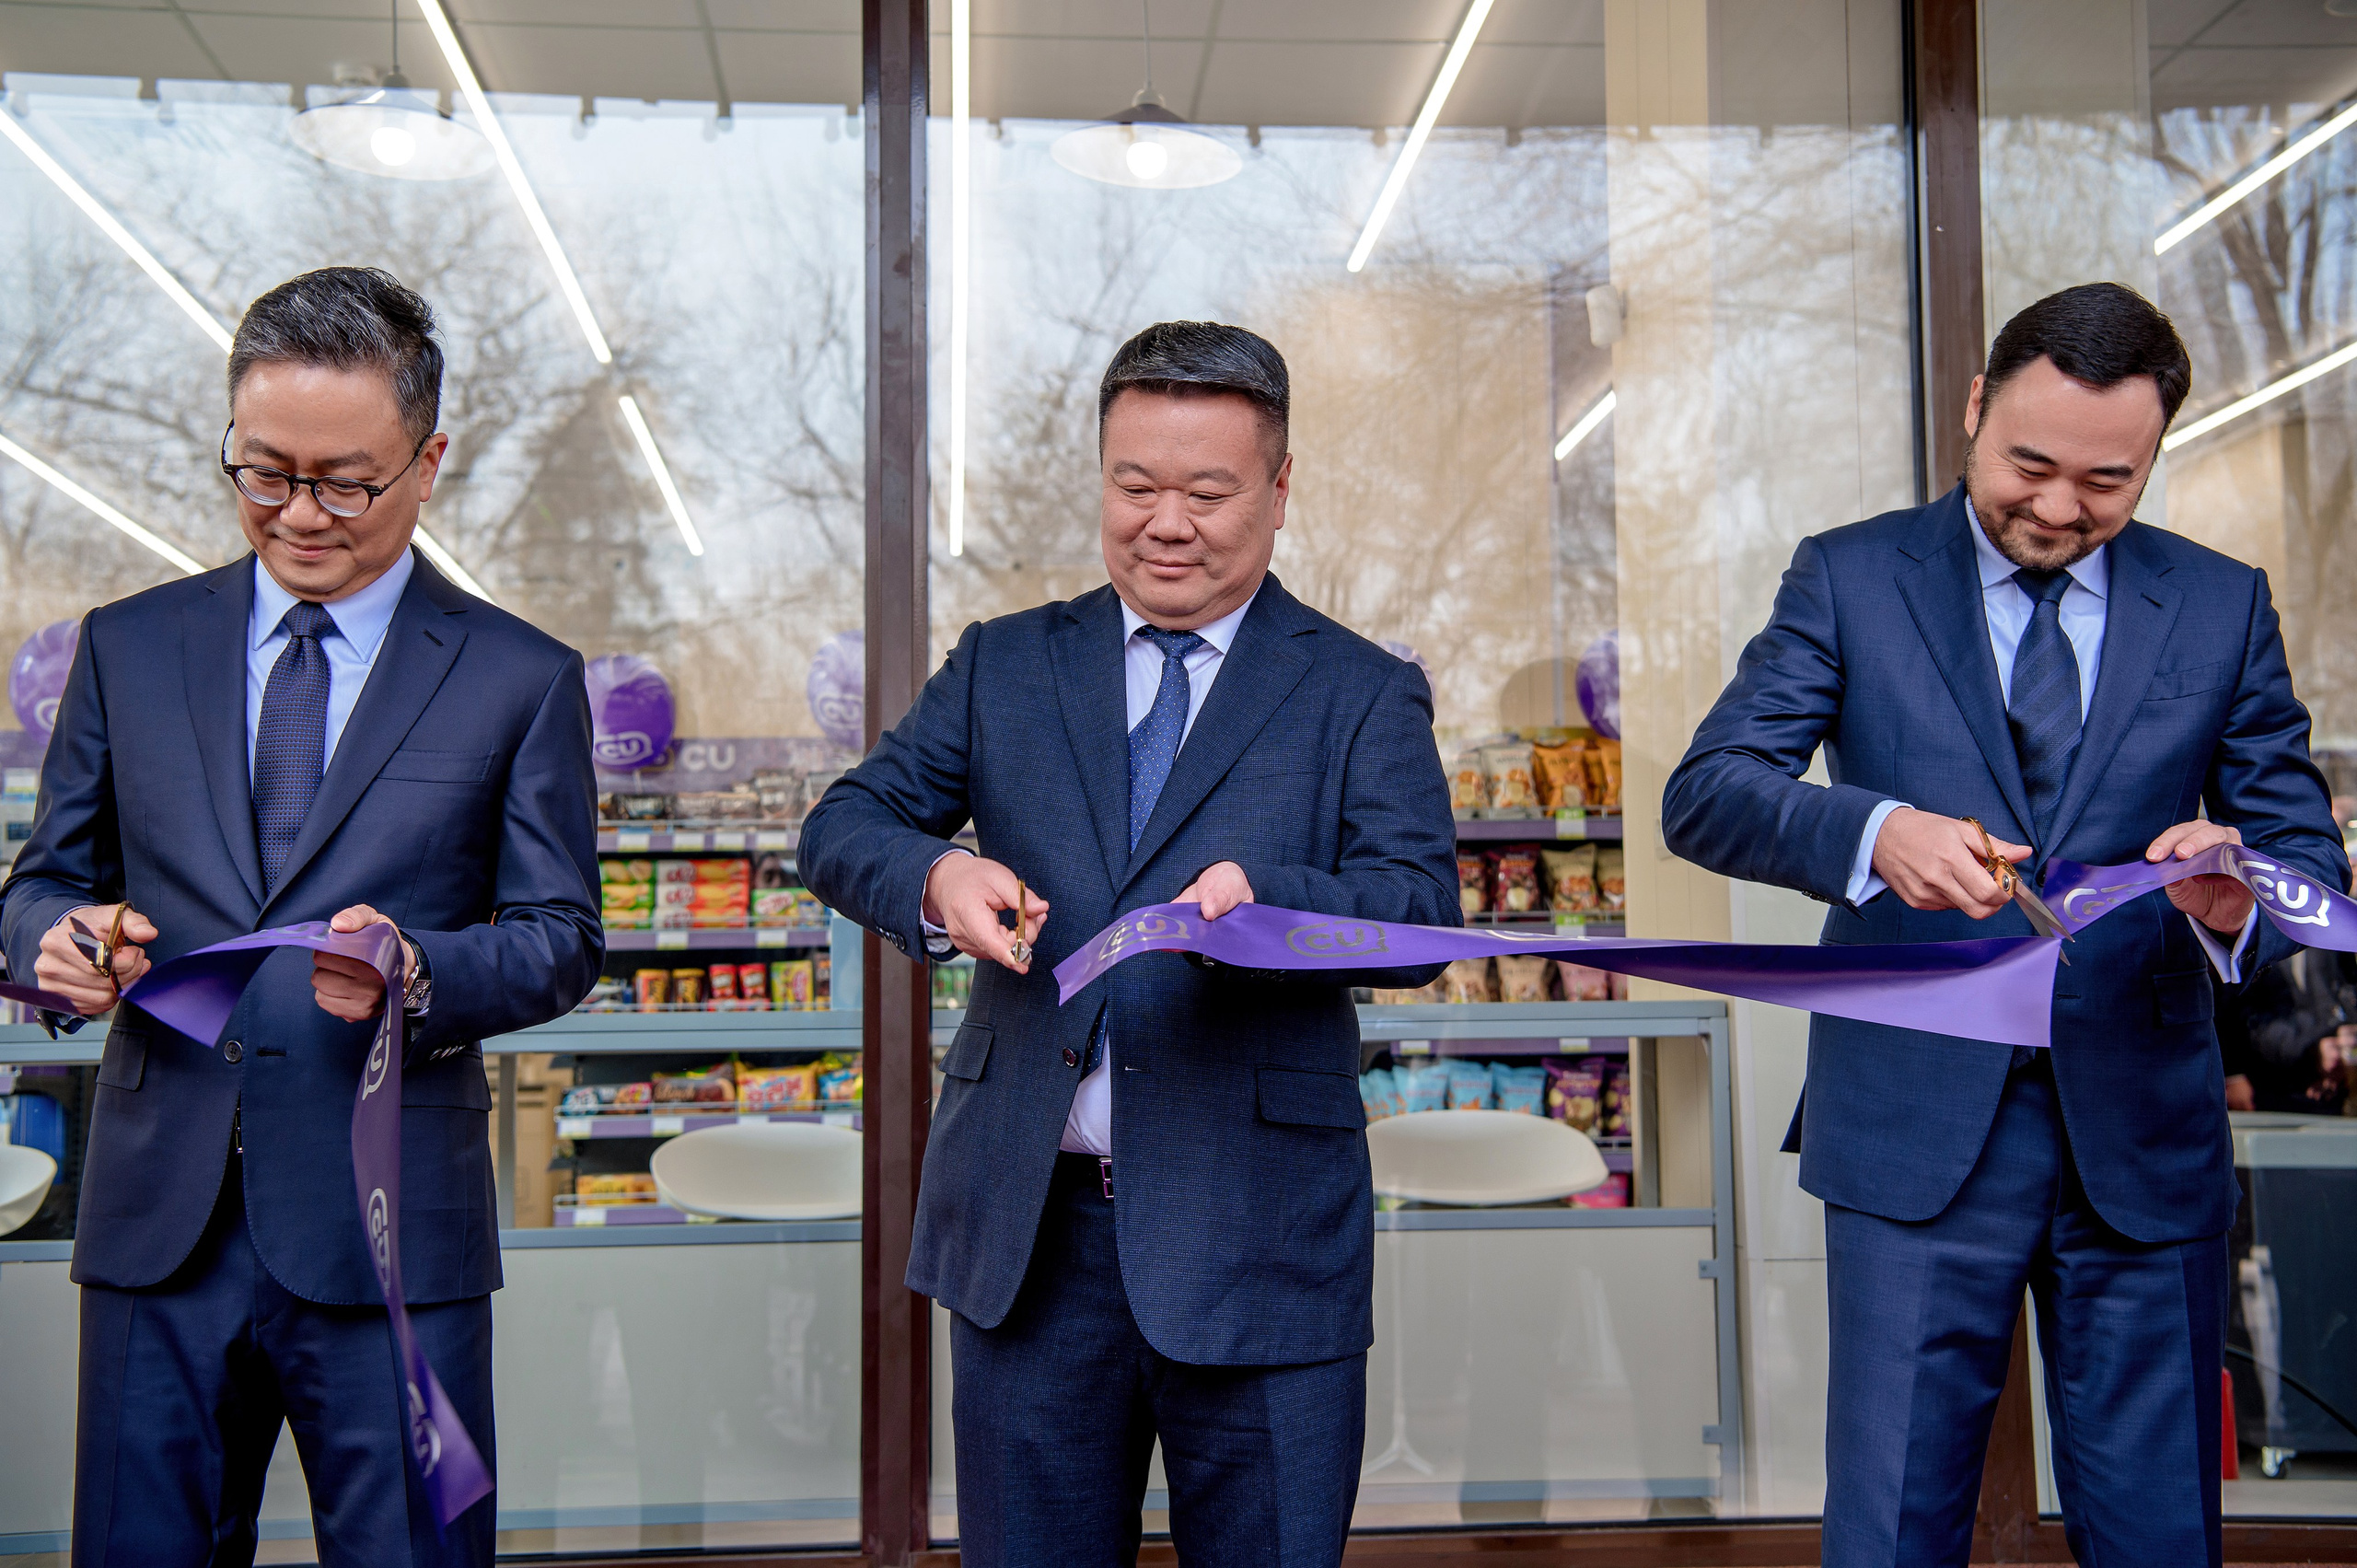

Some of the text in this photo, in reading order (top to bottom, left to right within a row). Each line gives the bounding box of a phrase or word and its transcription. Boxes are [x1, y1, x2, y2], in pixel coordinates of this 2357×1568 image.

[600, 739, 639, 758] CU
[680, 743, 736, 772] CU
[2250, 875, 2309, 909] CU
[1110, 919, 1167, 947] CU
[1305, 927, 1364, 950] CU
